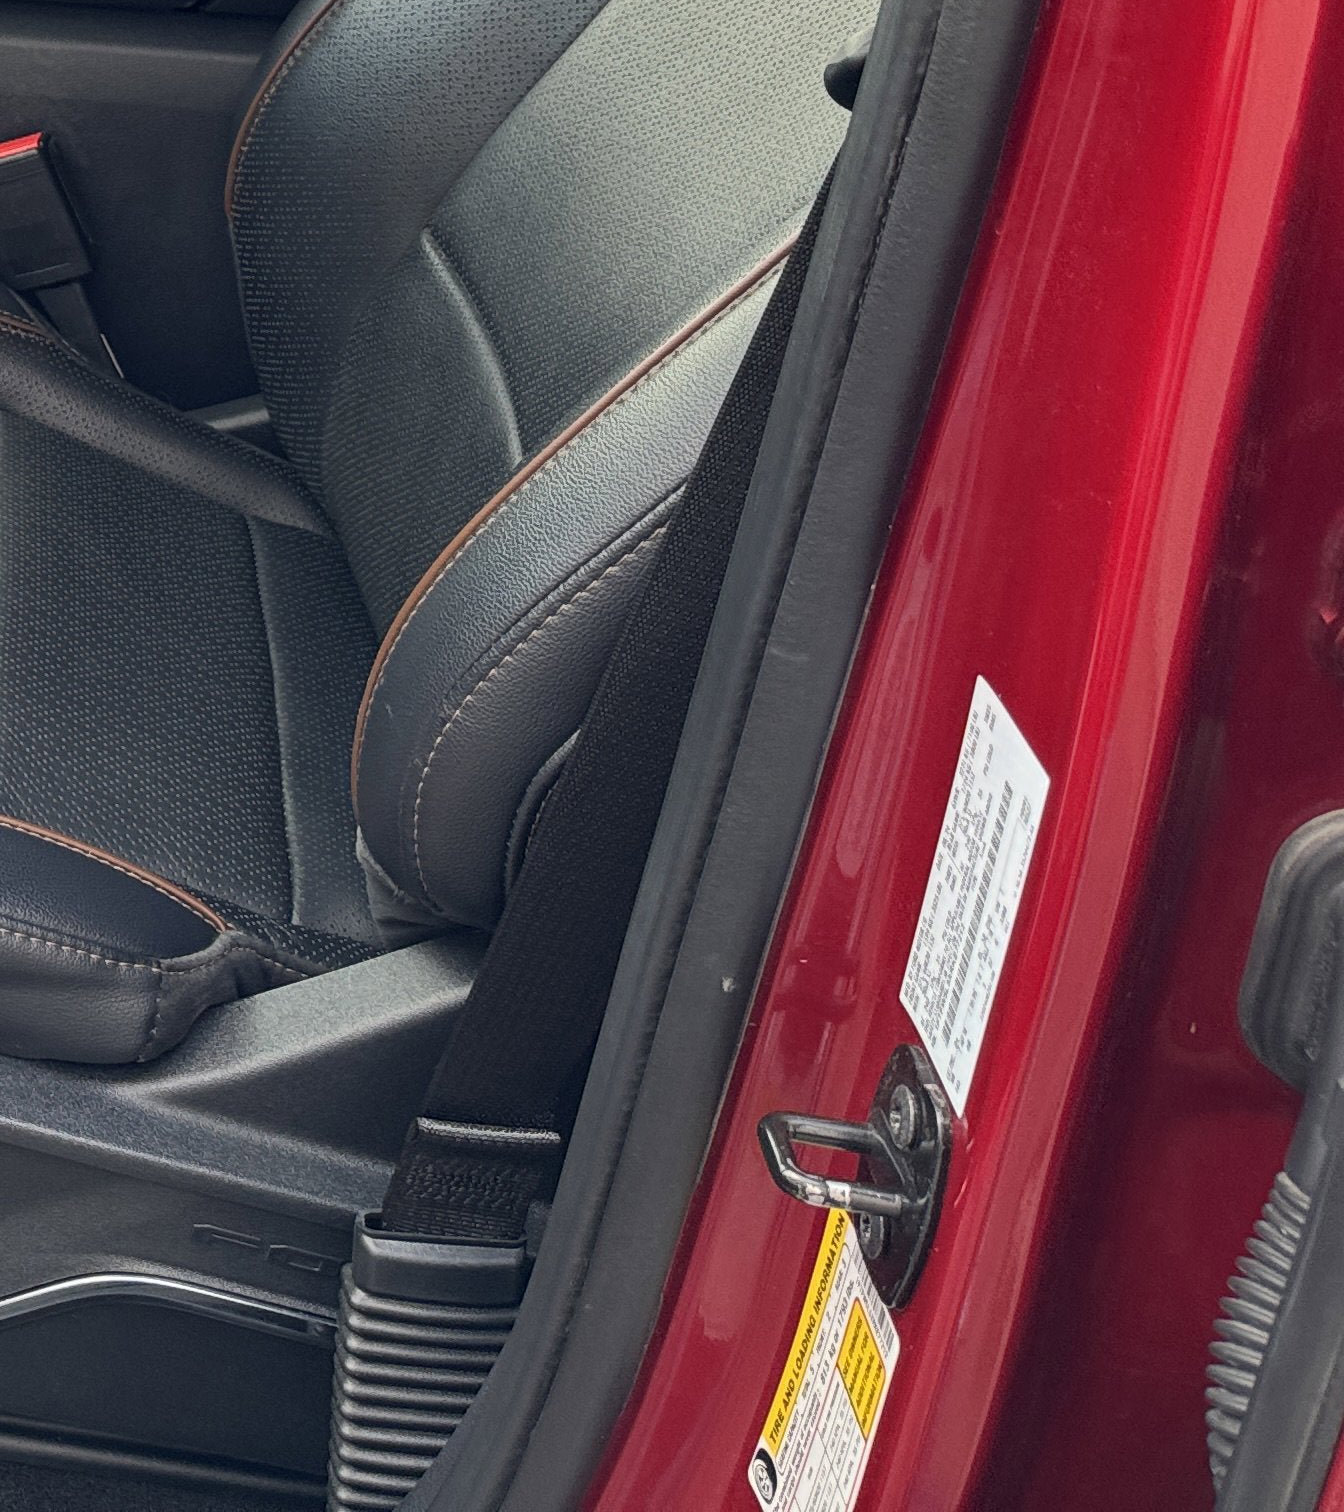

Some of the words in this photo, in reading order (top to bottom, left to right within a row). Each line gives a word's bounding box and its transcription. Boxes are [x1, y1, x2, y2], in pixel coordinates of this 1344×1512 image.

[769, 1408, 786, 1445] TIRE
[782, 1379, 796, 1409] AND
[795, 1316, 816, 1376] LOADING
[812, 1212, 846, 1315] INFORMATION
[828, 1343, 837, 1360] kg
[833, 1330, 840, 1343] or
[837, 1301, 848, 1329] 1793
[860, 1330, 870, 1353] FOR
